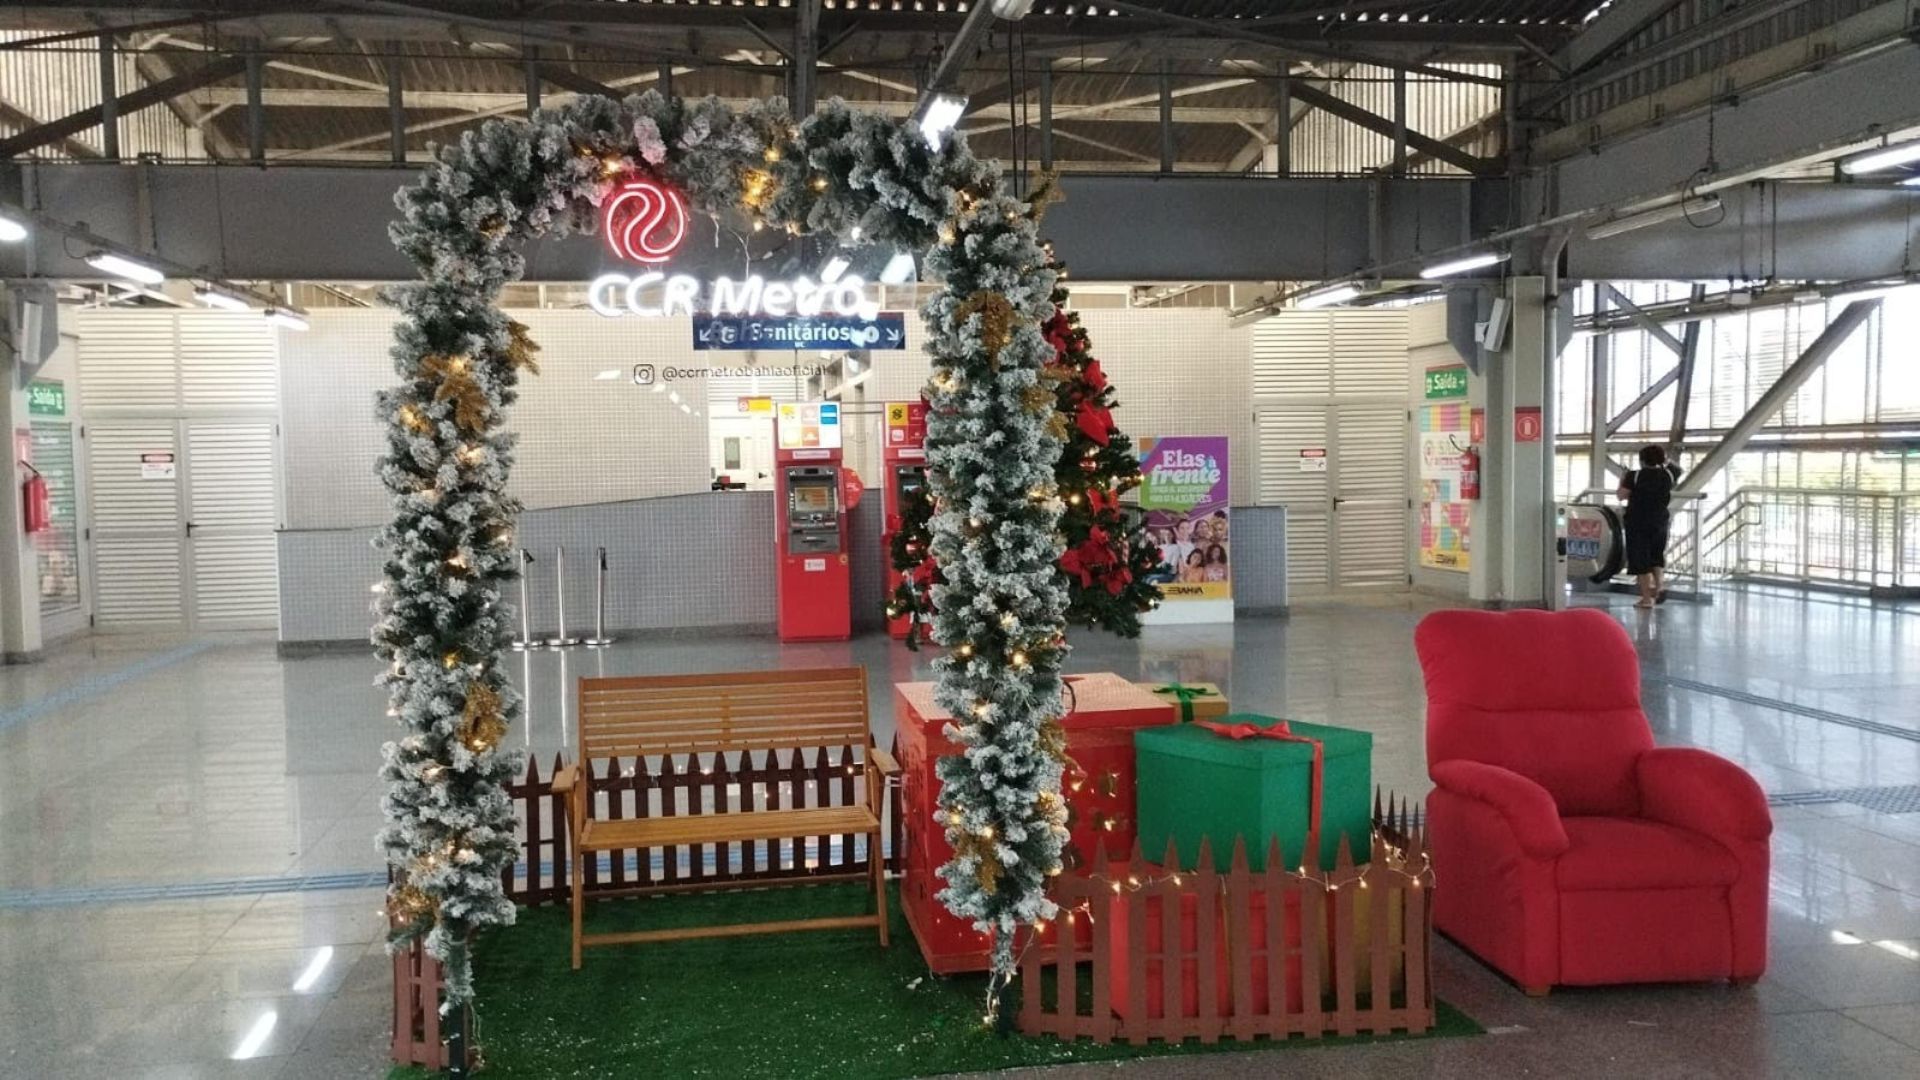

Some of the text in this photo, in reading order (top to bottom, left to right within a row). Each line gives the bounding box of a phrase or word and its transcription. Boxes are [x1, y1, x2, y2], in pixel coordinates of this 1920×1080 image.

[589, 273, 699, 316] CCR
[751, 321, 850, 341] Sanitários
[1433, 373, 1457, 389] Saída
[33, 387, 55, 405] Saída
[1162, 449, 1205, 467] Elas
[1151, 465, 1220, 485] frente
